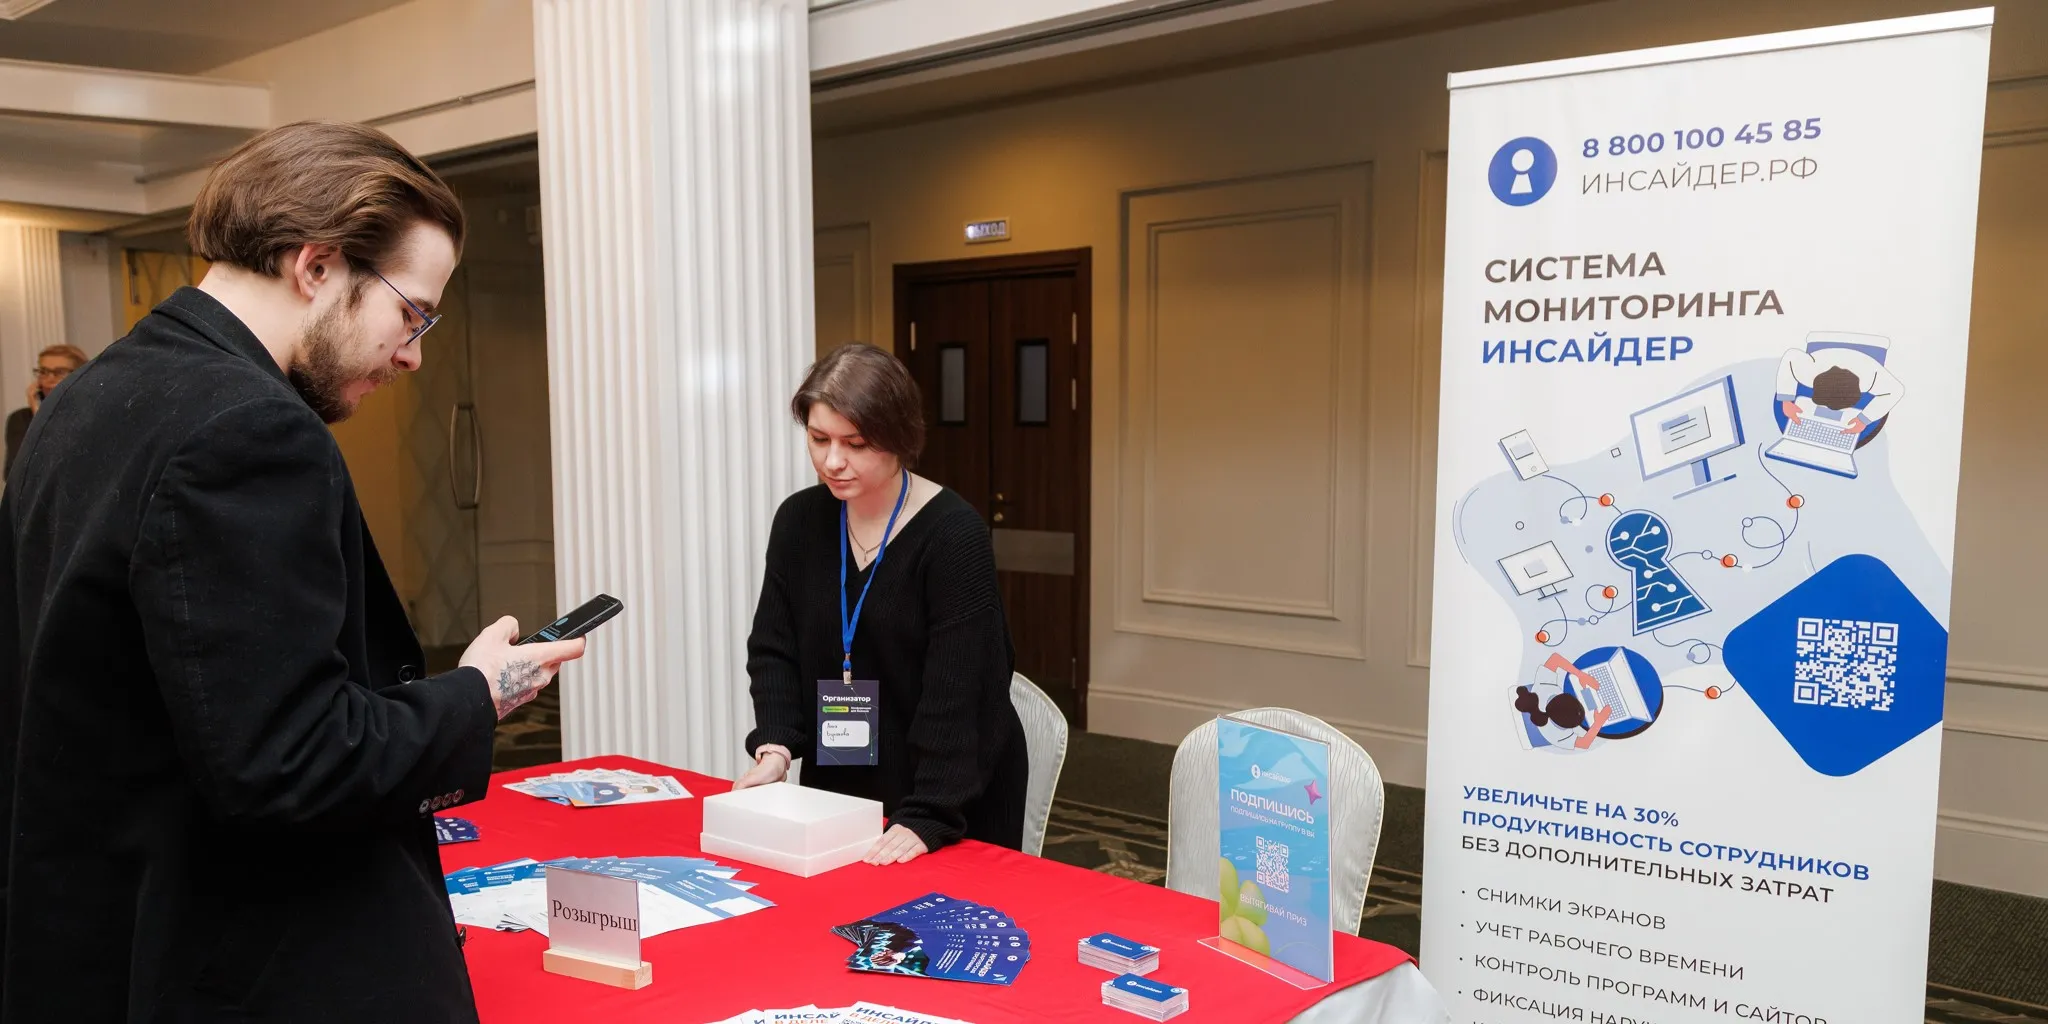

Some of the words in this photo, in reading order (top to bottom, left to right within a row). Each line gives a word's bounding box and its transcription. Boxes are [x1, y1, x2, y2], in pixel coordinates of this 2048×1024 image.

[1582, 137, 1600, 159] 8
[1608, 132, 1665, 156] 800
[1674, 126, 1725, 151] 100
[1734, 121, 1774, 145] 45
[1783, 117, 1822, 141] 85
[1582, 155, 1818, 195] ИНСАЙДЕР.РФ
[1484, 251, 1667, 284] СИСТЕМА
[1483, 289, 1785, 324] МОНИТОРИНГА
[1482, 332, 1694, 367] ИНСАЙДЕР
[822, 695, 871, 703] Организатор
[1231, 788, 1315, 825] ПОДПИШИСЬ
[1463, 785, 1589, 816] УВЕЛИЧЬТЕ
[1595, 801, 1628, 821] НА
[1634, 806, 1680, 828] 30%
[1462, 810, 1673, 853] ПРОДУКТИВНОСТЬ
[1680, 840, 1870, 882] СОТРУДНИКОВ
[1461, 835, 1500, 854] БЕЗ
[1505, 841, 1734, 890] ДОПОЛНИТЕЛЬНЫХ
[1741, 876, 1835, 904] ЗАТРАТ
[552, 899, 637, 931] Розыгрыш
[1286, 911, 1307, 926] ПРИЗ
[1477, 887, 1563, 914] СНИМКИ
[1568, 901, 1667, 931] ЭКРАНОВ
[1475, 920, 1523, 941] УЧЕТ
[1528, 930, 1633, 961] РАБОЧЕГО
[1639, 949, 1745, 981] ВРЕМЕНИ
[1475, 954, 1581, 986] КОНТРОЛЬ
[1586, 975, 1706, 1010] ПРОГРАММ
[1713, 998, 1728, 1014] И
[1473, 988, 1584, 1022] ФИКСАЦИЯ
